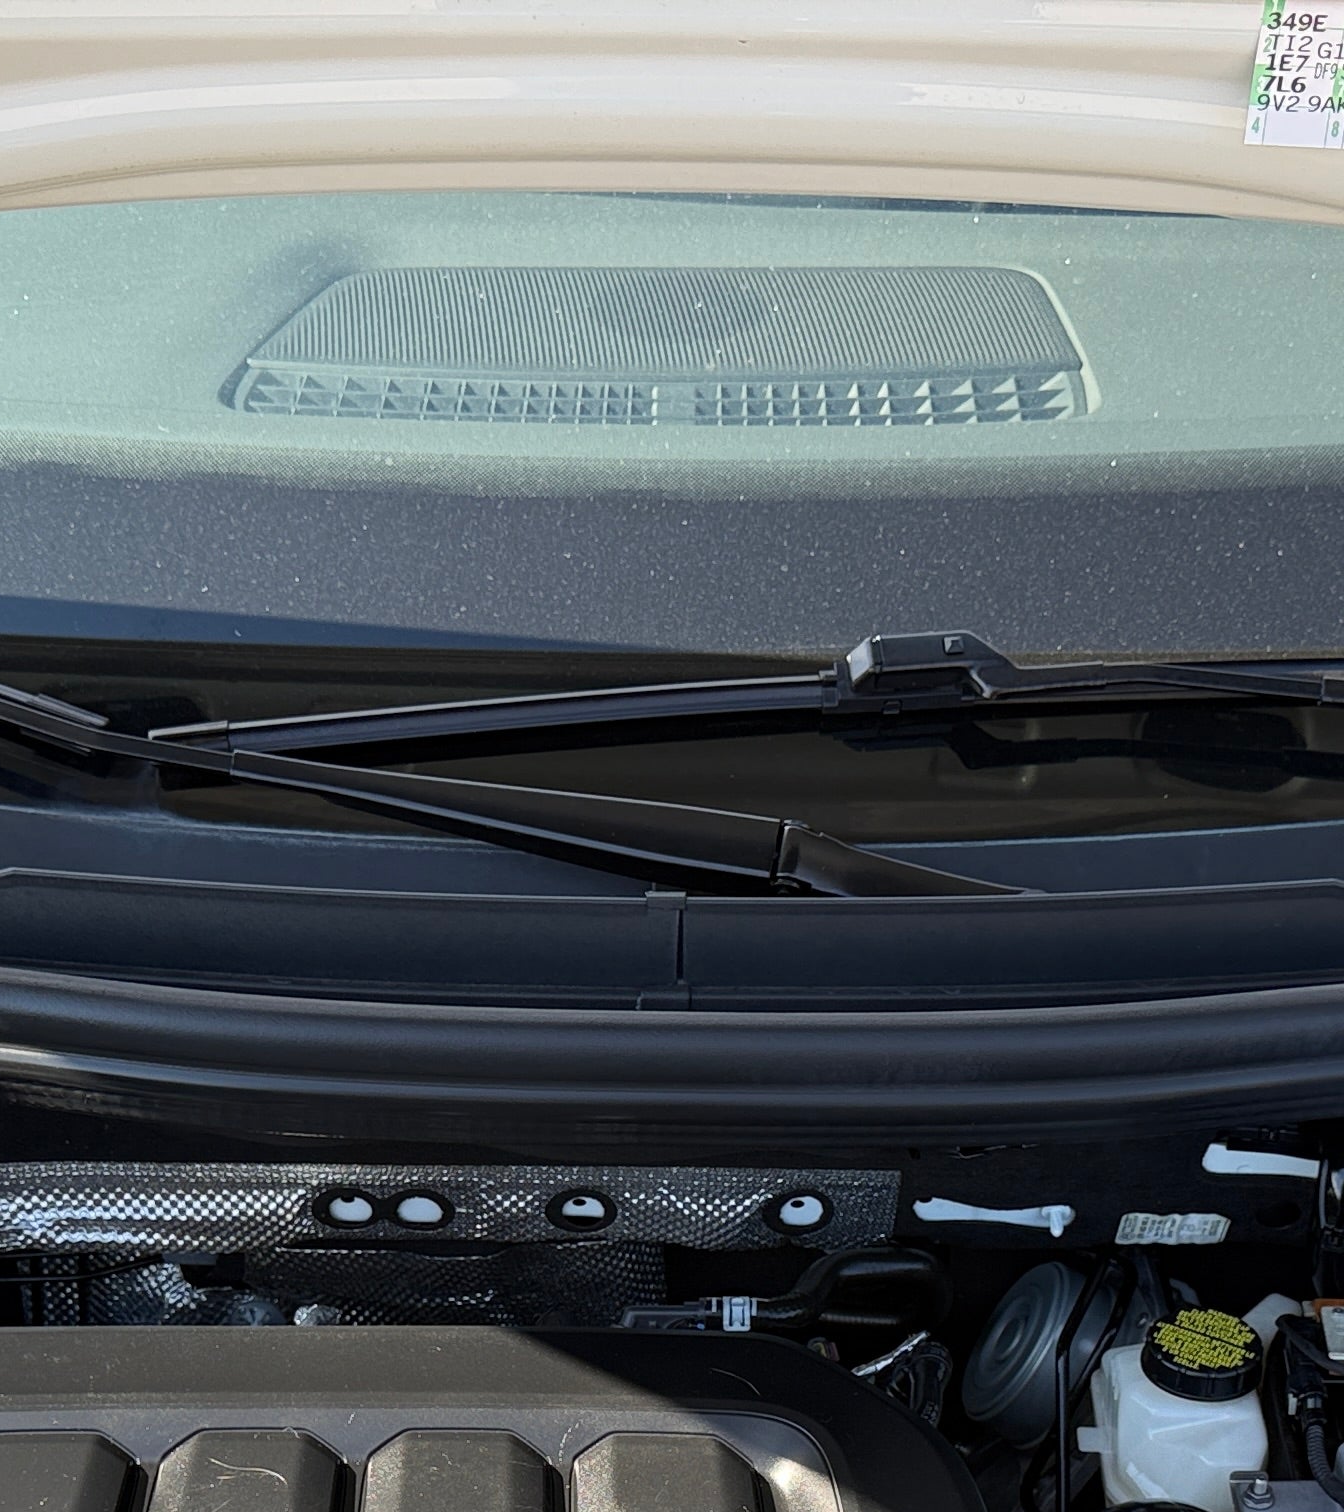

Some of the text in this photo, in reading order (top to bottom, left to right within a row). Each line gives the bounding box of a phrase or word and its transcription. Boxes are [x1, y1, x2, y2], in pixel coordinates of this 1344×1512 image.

[1267, 12, 1328, 32] 349E
[1265, 54, 1311, 72] 1E7
[1262, 75, 1307, 93] 7L6
[1257, 94, 1300, 112] 9V2
[1331, 121, 1339, 137] 8
